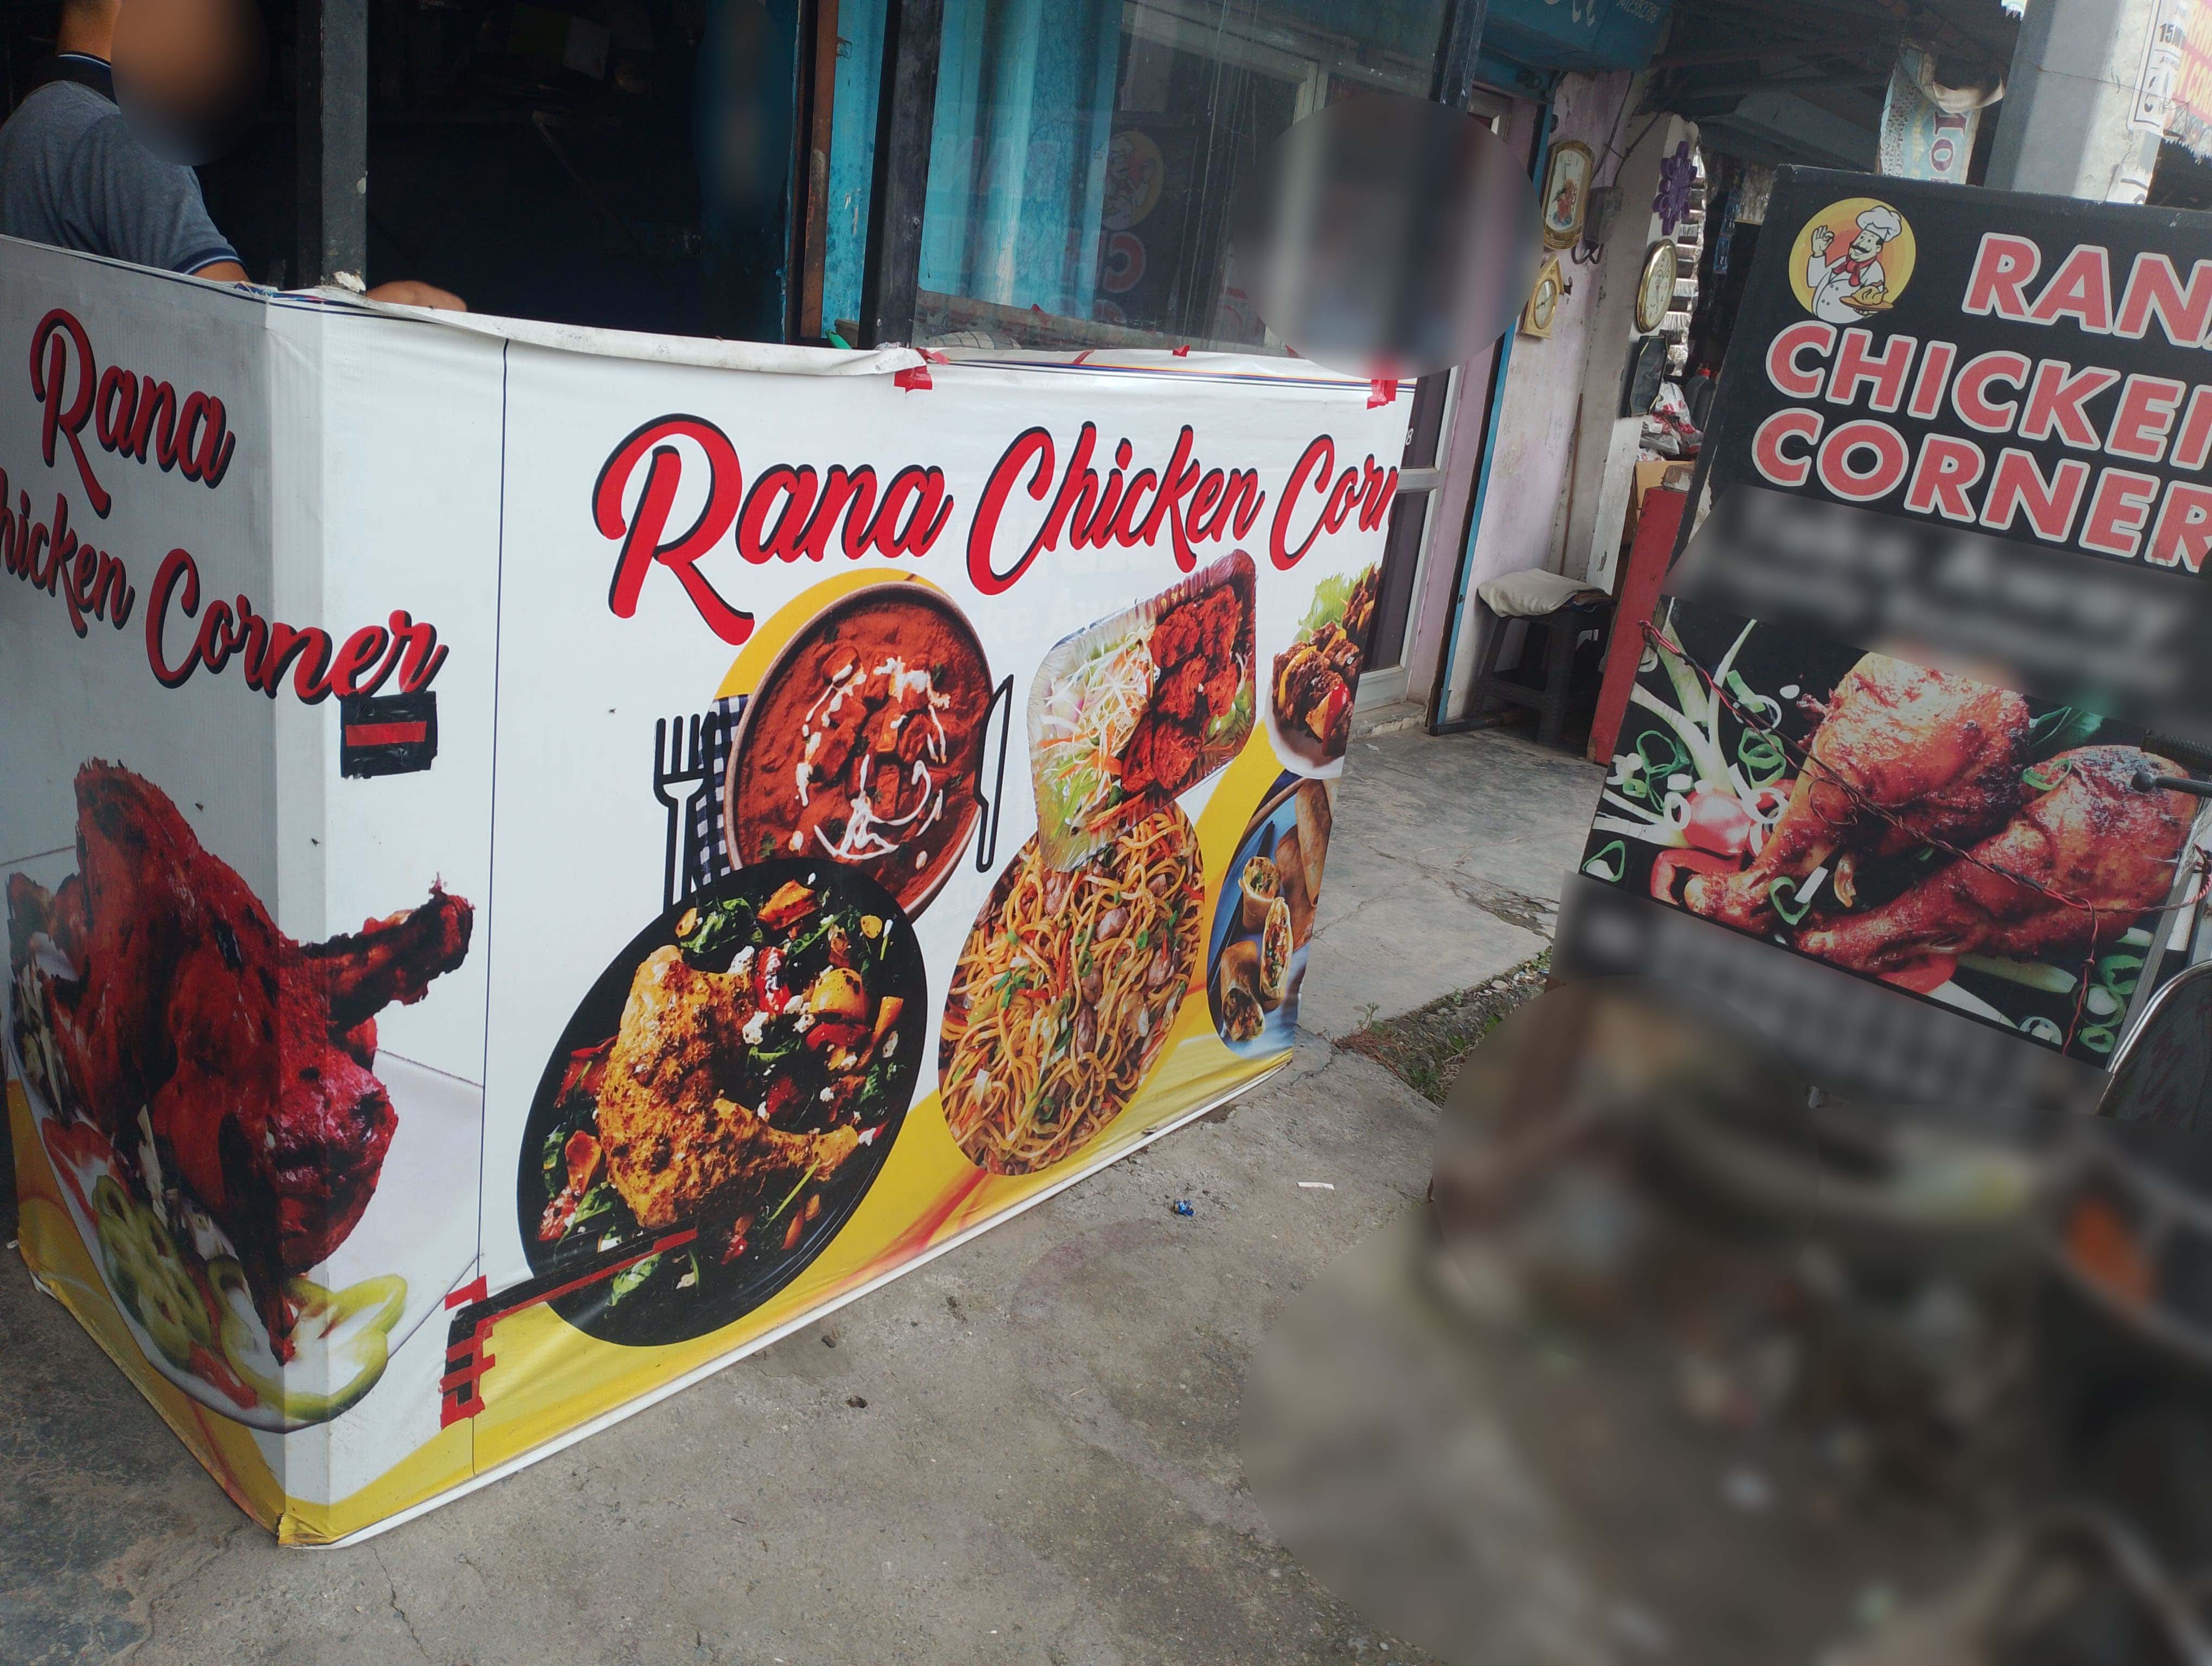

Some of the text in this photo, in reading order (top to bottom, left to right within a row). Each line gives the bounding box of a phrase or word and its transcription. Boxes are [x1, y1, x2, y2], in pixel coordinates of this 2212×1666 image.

[1962, 232, 2212, 349] RAN
[30, 307, 236, 520] Rana
[1751, 407, 2212, 573] CORNER
[591, 413, 954, 646] Rana
[966, 420, 1265, 595] Chicken
[146, 548, 450, 706] Corner
